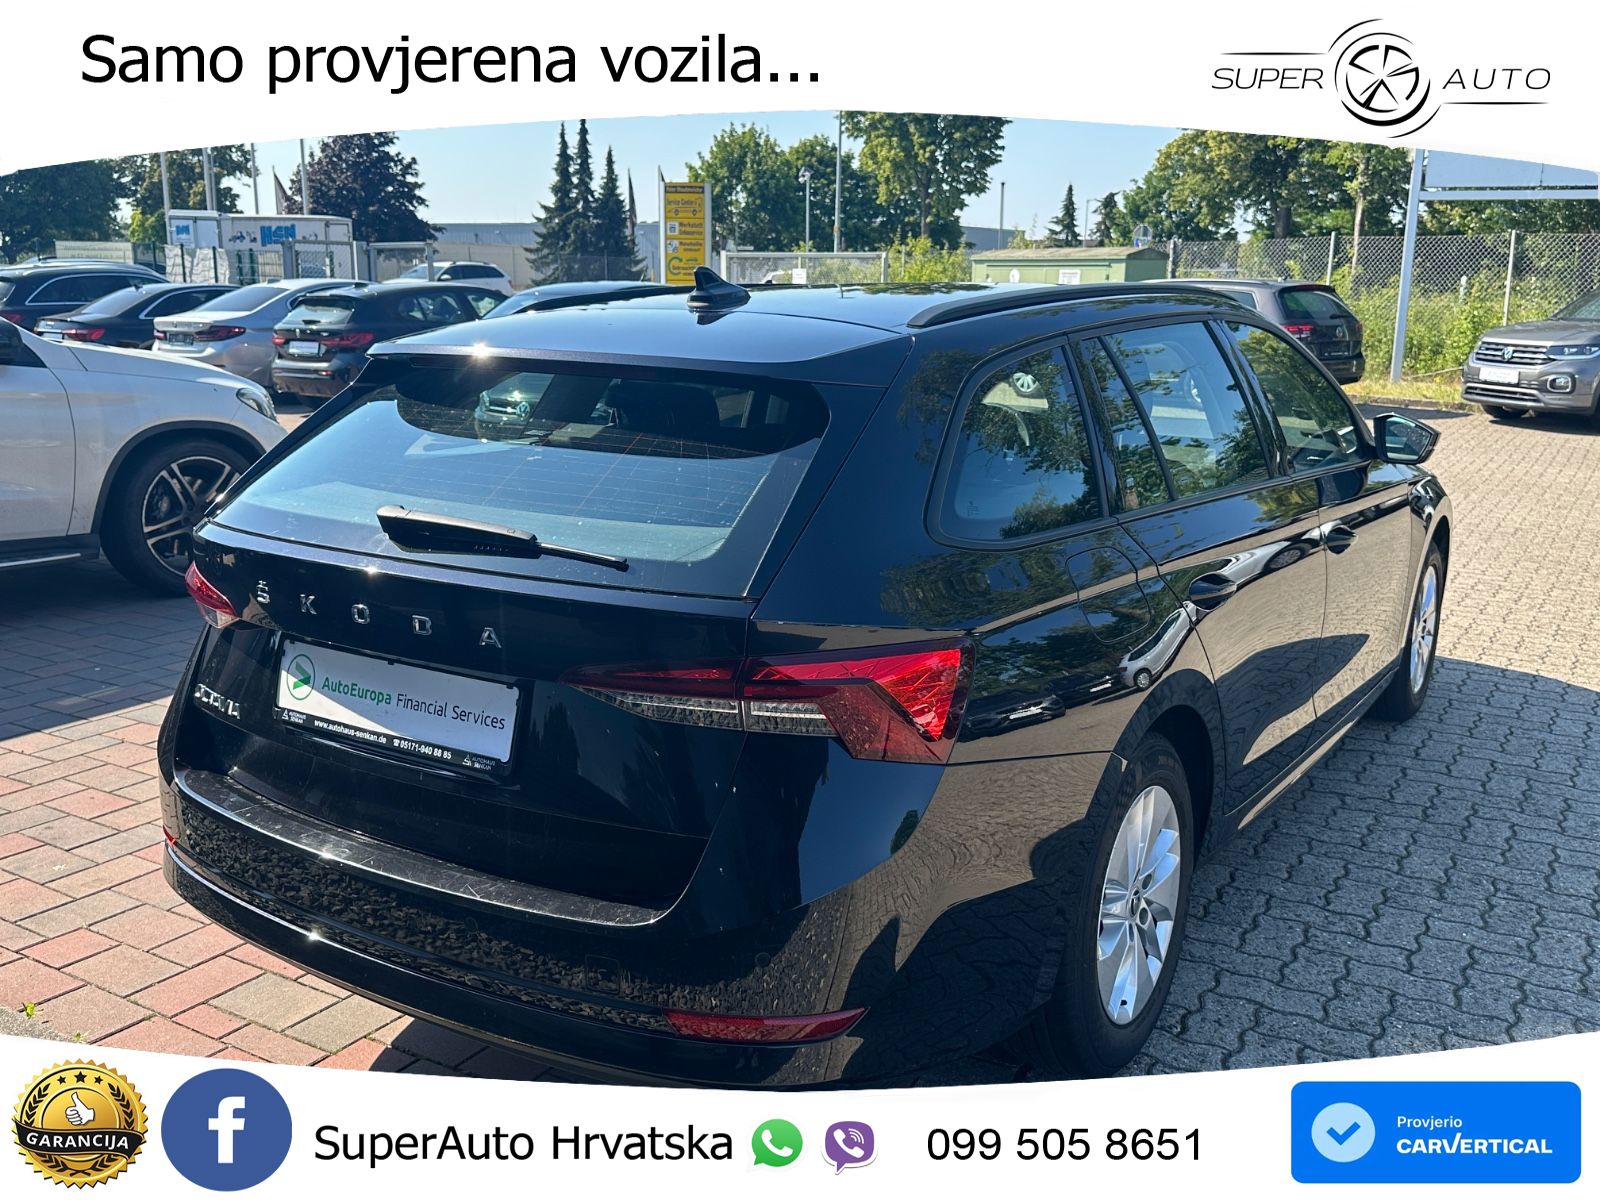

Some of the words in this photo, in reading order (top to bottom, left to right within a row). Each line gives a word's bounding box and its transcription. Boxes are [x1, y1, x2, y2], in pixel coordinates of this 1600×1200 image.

[322, 676, 392, 706] AutoEuropa
[396, 693, 448, 718] Financial
[451, 705, 506, 730] Services
[313, 719, 388, 744] www.autohaus-senkan.de
[400, 741, 433, 755] 05171-940
[442, 750, 452, 760] 85
